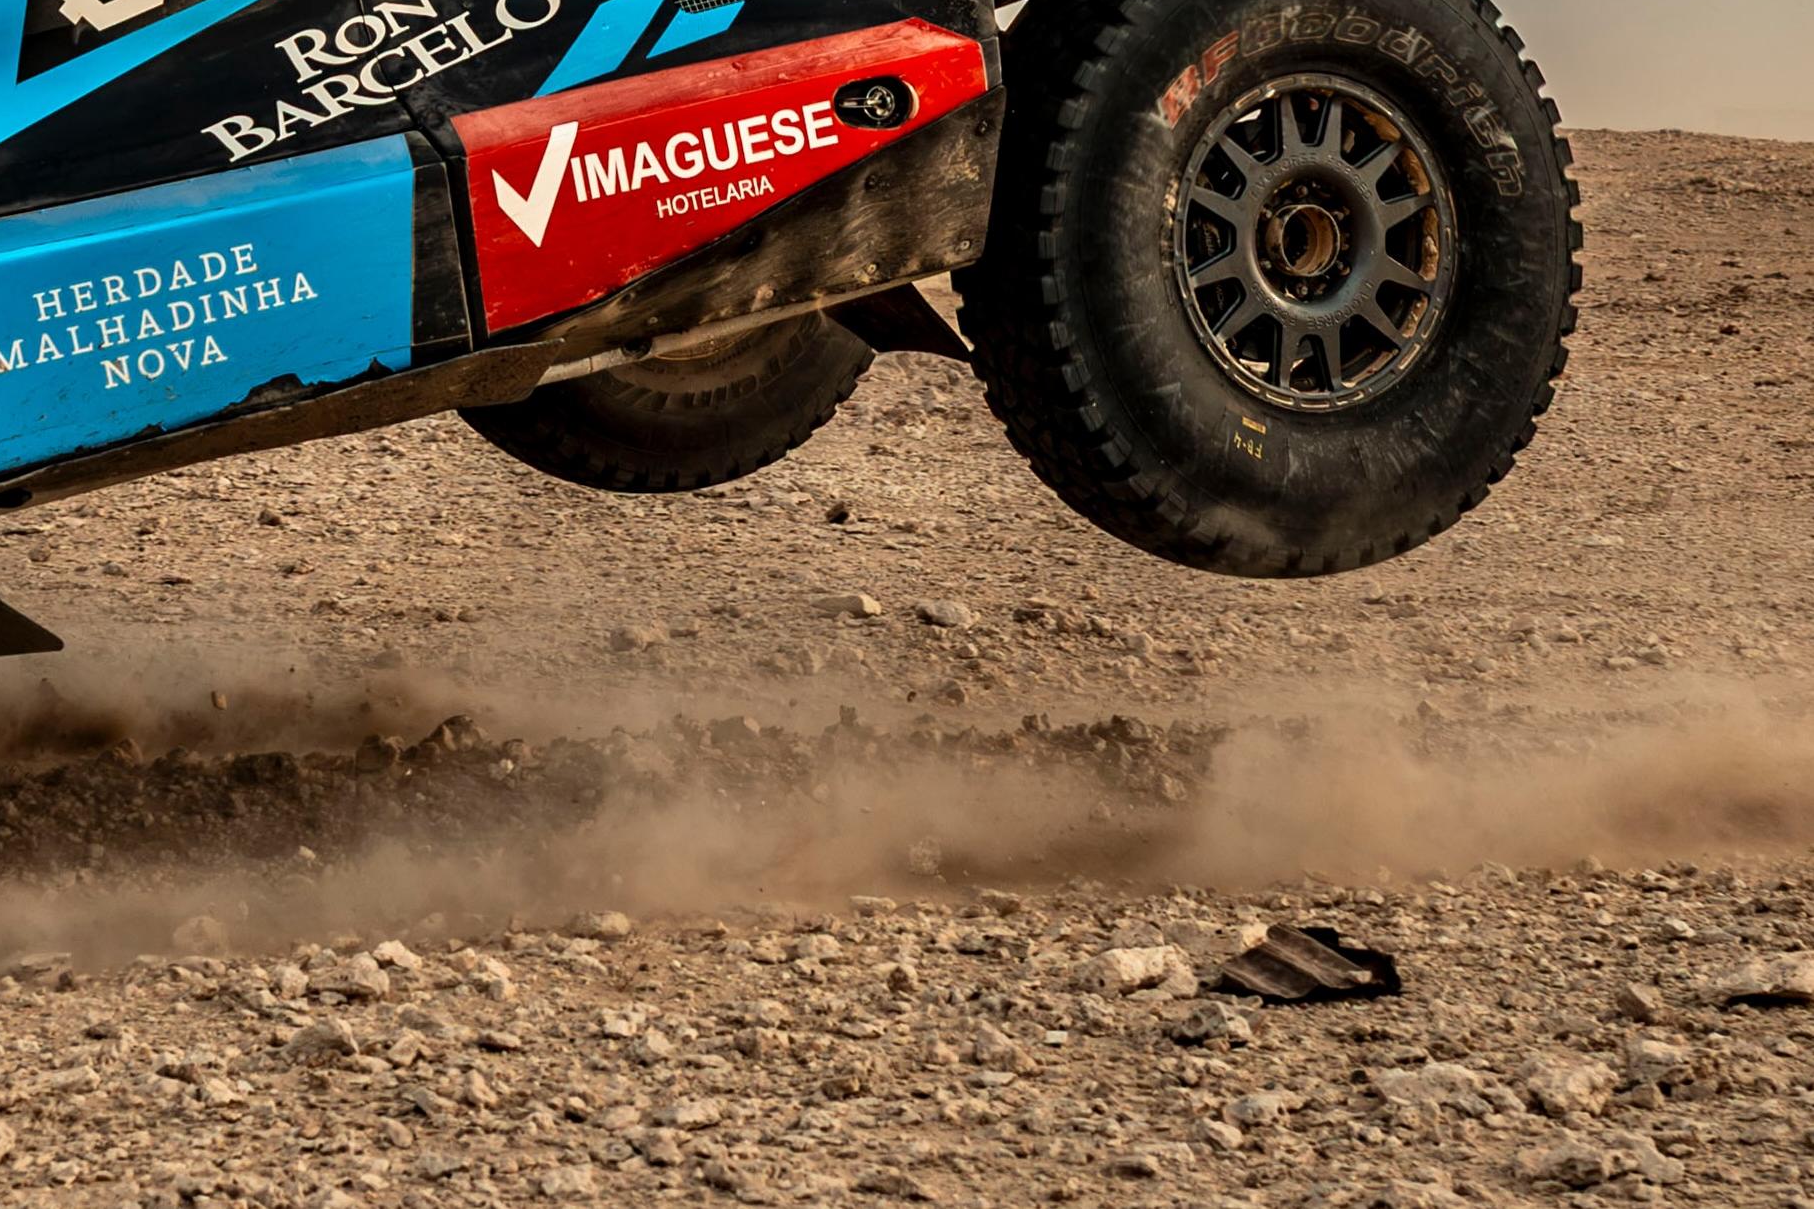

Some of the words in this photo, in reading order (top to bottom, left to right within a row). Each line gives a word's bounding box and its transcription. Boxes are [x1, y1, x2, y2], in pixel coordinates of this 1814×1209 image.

[655, 174, 775, 219] HOTELARIA
[34, 242, 259, 323] HERDADE
[100, 336, 229, 390] NOVA
